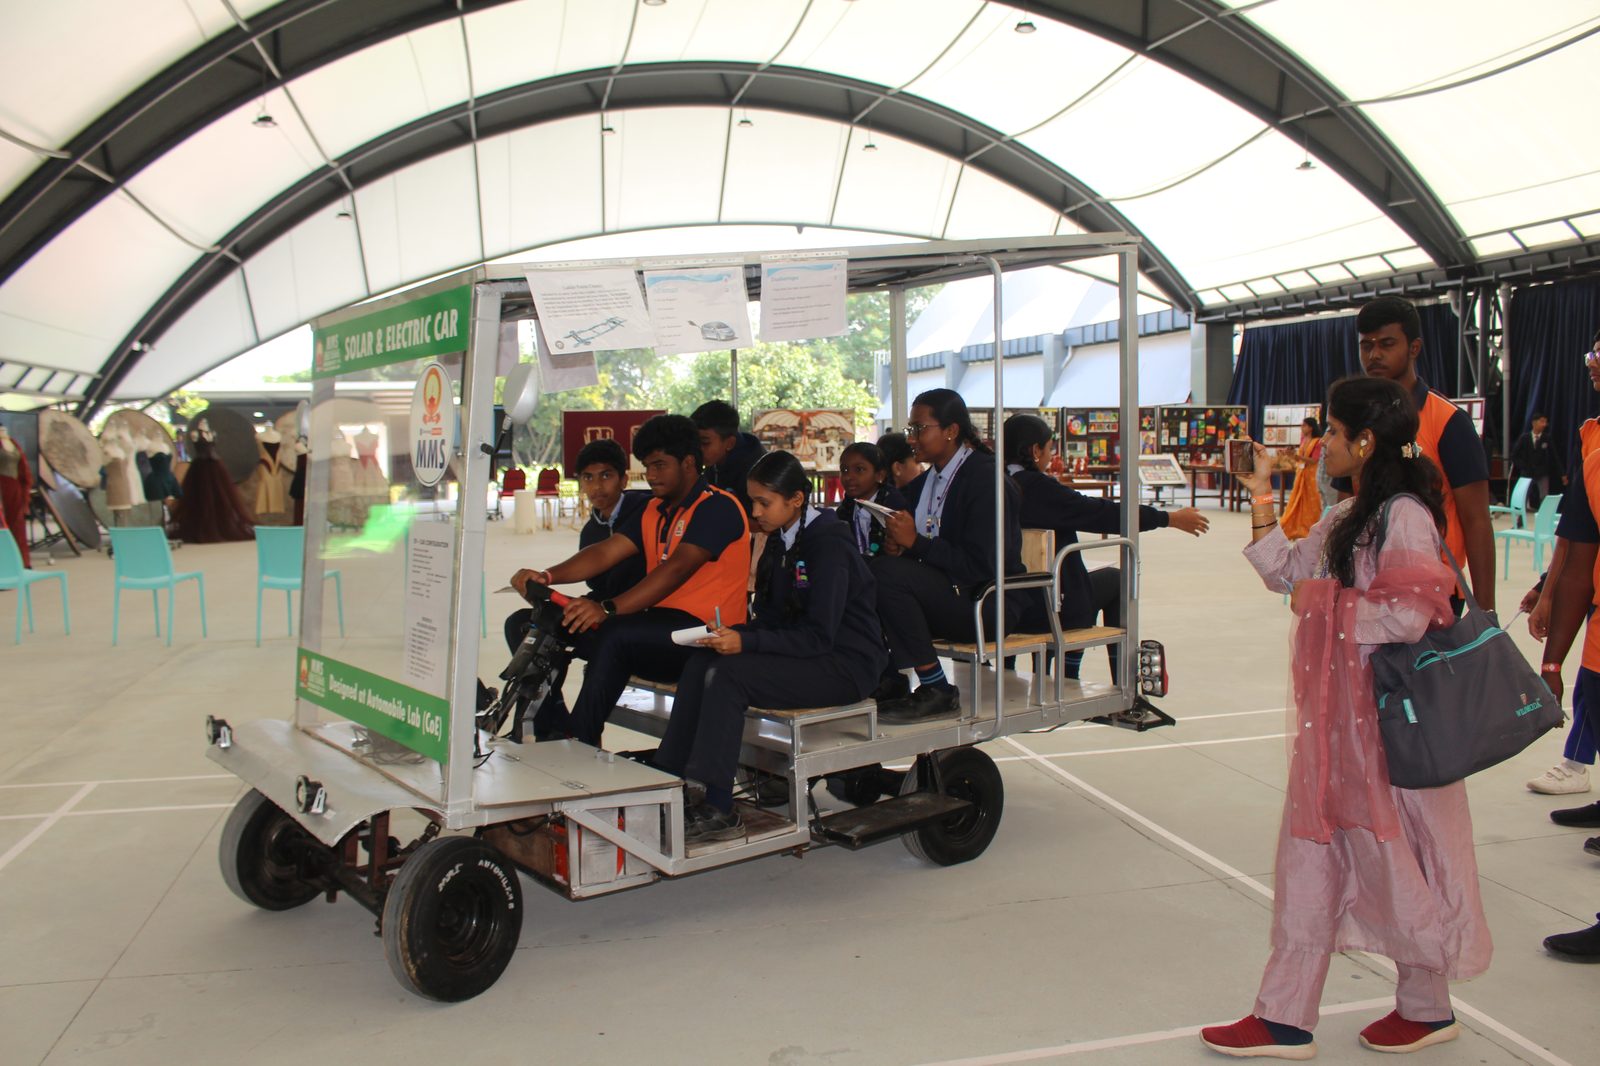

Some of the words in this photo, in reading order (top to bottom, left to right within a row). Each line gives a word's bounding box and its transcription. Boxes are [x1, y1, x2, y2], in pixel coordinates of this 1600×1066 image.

[344, 331, 374, 362] SOLAR
[375, 328, 384, 354] &
[386, 314, 432, 352] ELECTRIC
[434, 308, 459, 341] CAR
[415, 439, 446, 470] MMS
[329, 673, 358, 701] Designed
[359, 689, 367, 704] at
[367, 687, 406, 722] Automobile
[407, 704, 421, 729] Lab
[422, 710, 442, 742] (CoE)
